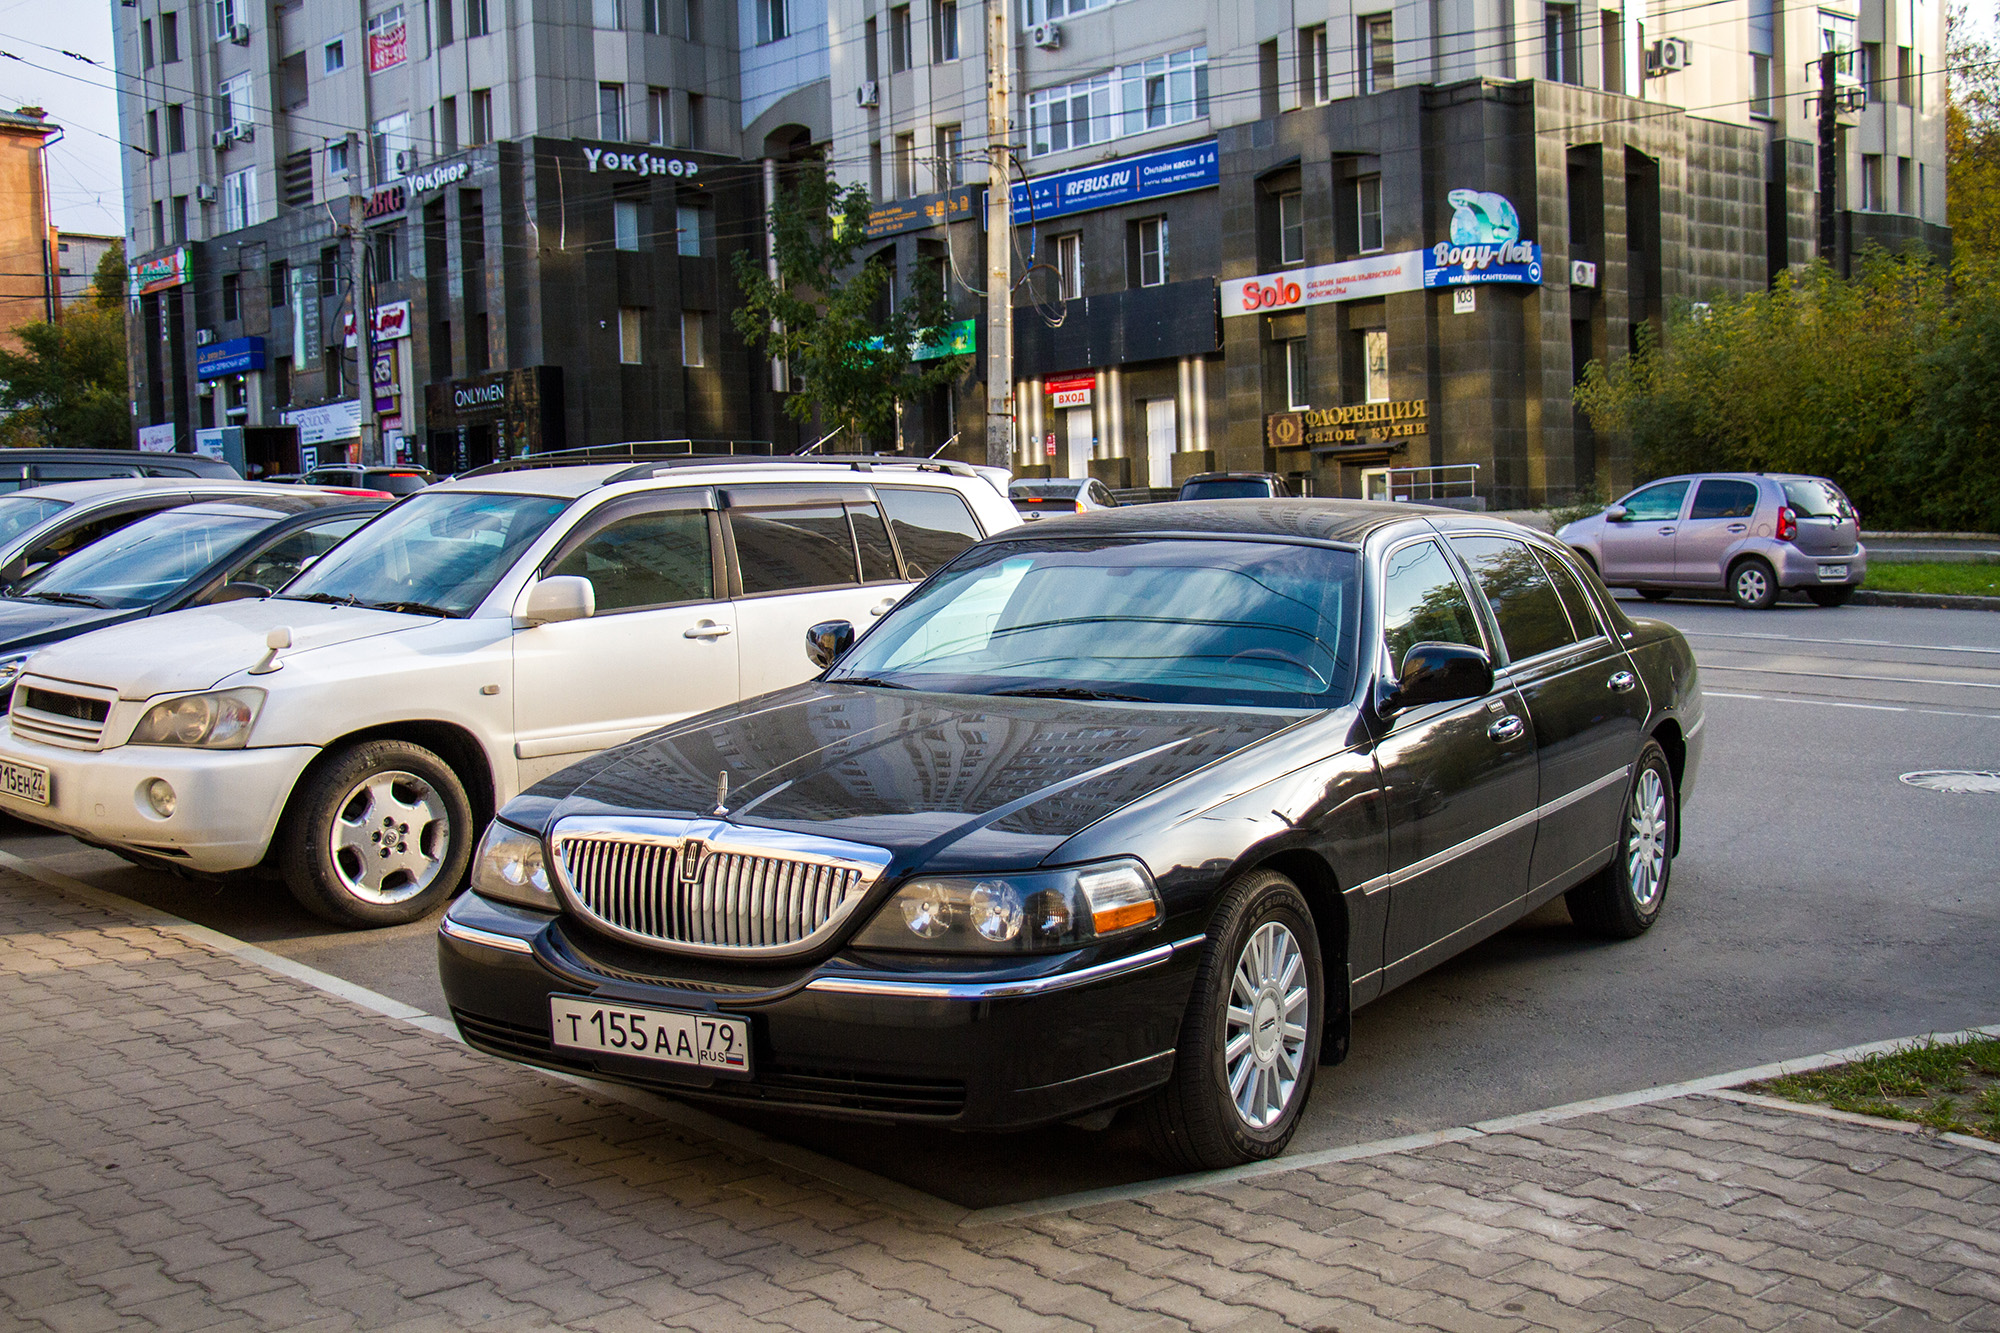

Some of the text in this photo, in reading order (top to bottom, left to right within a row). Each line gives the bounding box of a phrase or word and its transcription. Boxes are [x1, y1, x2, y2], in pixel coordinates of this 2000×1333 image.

[583, 147, 698, 178] YOKSHOP
[1143, 163, 1172, 176] Онлайн
[407, 163, 468, 197] YOKSHOP
[1065, 170, 1130, 196] RFBUS.RU
[1306, 266, 1402, 289] салон итальянской
[1448, 274, 1480, 284] МАГАЗИН
[1242, 276, 1301, 310] Solo
[1306, 286, 1347, 299] одежды
[1456, 290, 1473, 303] 103
[455, 384, 504, 407] ONLYMEN
[1058, 392, 1085, 404] ВХОД
[1304, 399, 1428, 427] ФЛОРЕНЦИЯ
[1305, 422, 1426, 444] салон кухни
[701, 1021, 735, 1052] 79
[701, 1050, 725, 1064] RUS
